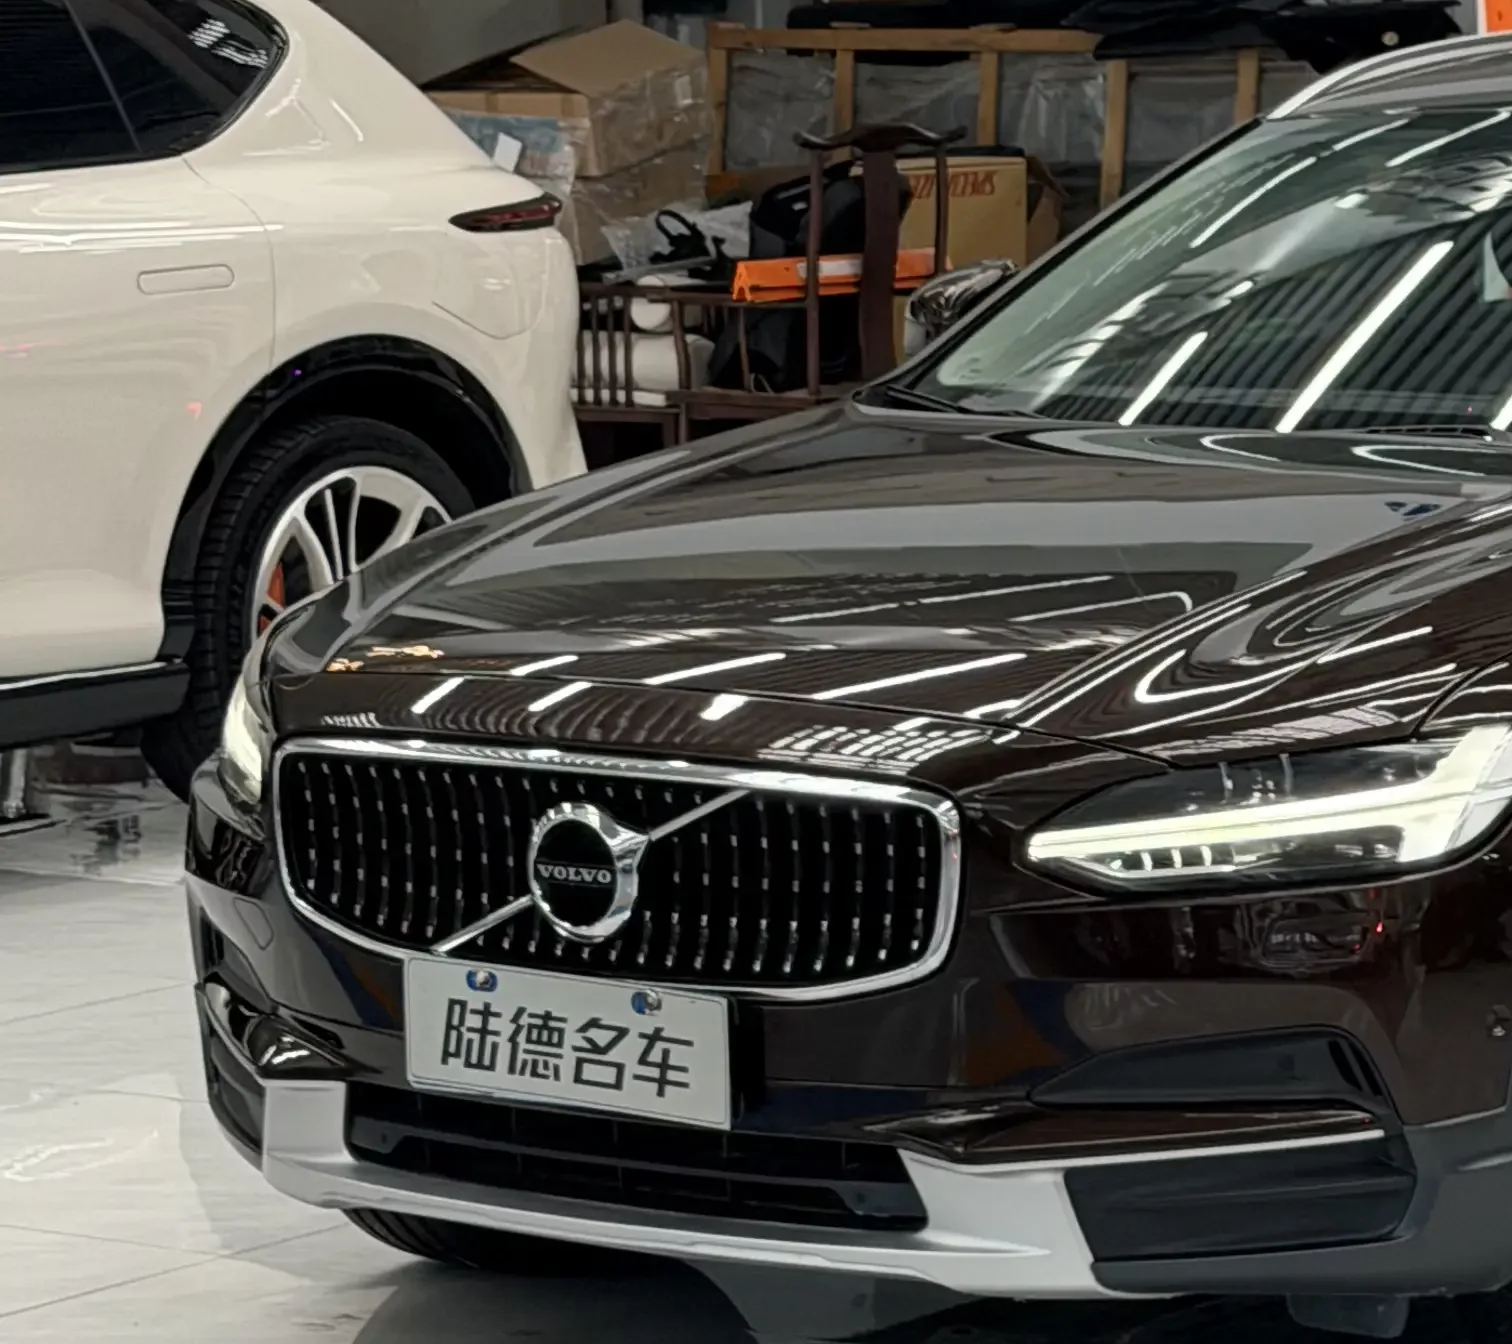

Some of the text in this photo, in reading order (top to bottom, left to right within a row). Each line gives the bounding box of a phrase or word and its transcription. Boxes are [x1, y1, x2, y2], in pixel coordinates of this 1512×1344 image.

[536, 862, 612, 885] VOLVO
[440, 997, 695, 1099] 陆德名车
